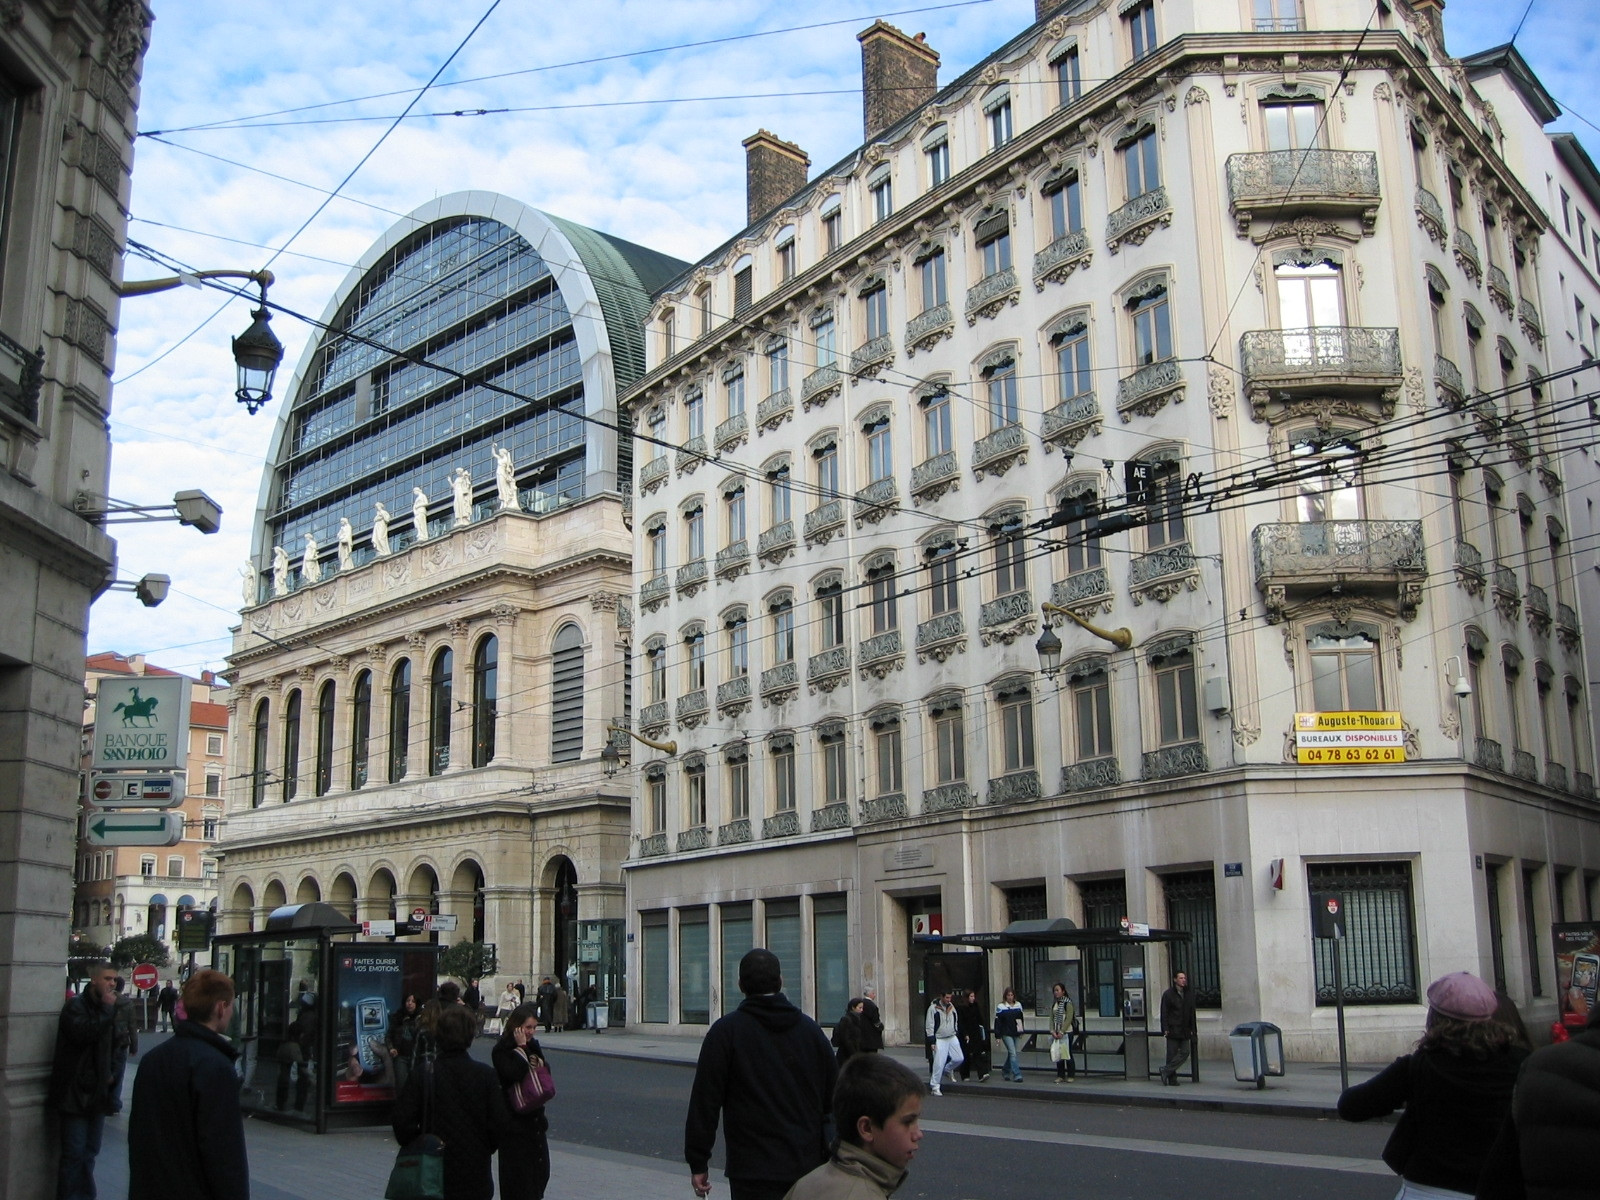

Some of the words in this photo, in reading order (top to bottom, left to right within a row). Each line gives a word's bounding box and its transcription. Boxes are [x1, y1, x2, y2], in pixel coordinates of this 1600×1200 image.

[1133, 467, 1146, 478] AE
[1138, 480, 1143, 491] 1
[1318, 715, 1395, 728] Auguste-Thouard
[105, 733, 167, 747] BANQUE
[1301, 735, 1342, 743] BUREAUX
[1345, 734, 1398, 742] DISPONIBLES
[103, 747, 167, 761] SANPAOLO
[1308, 750, 1322, 760] 04
[1327, 750, 1341, 760] 78
[1346, 749, 1360, 760] 63
[1365, 749, 1379, 760] 62
[1383, 749, 1395, 759] 61
